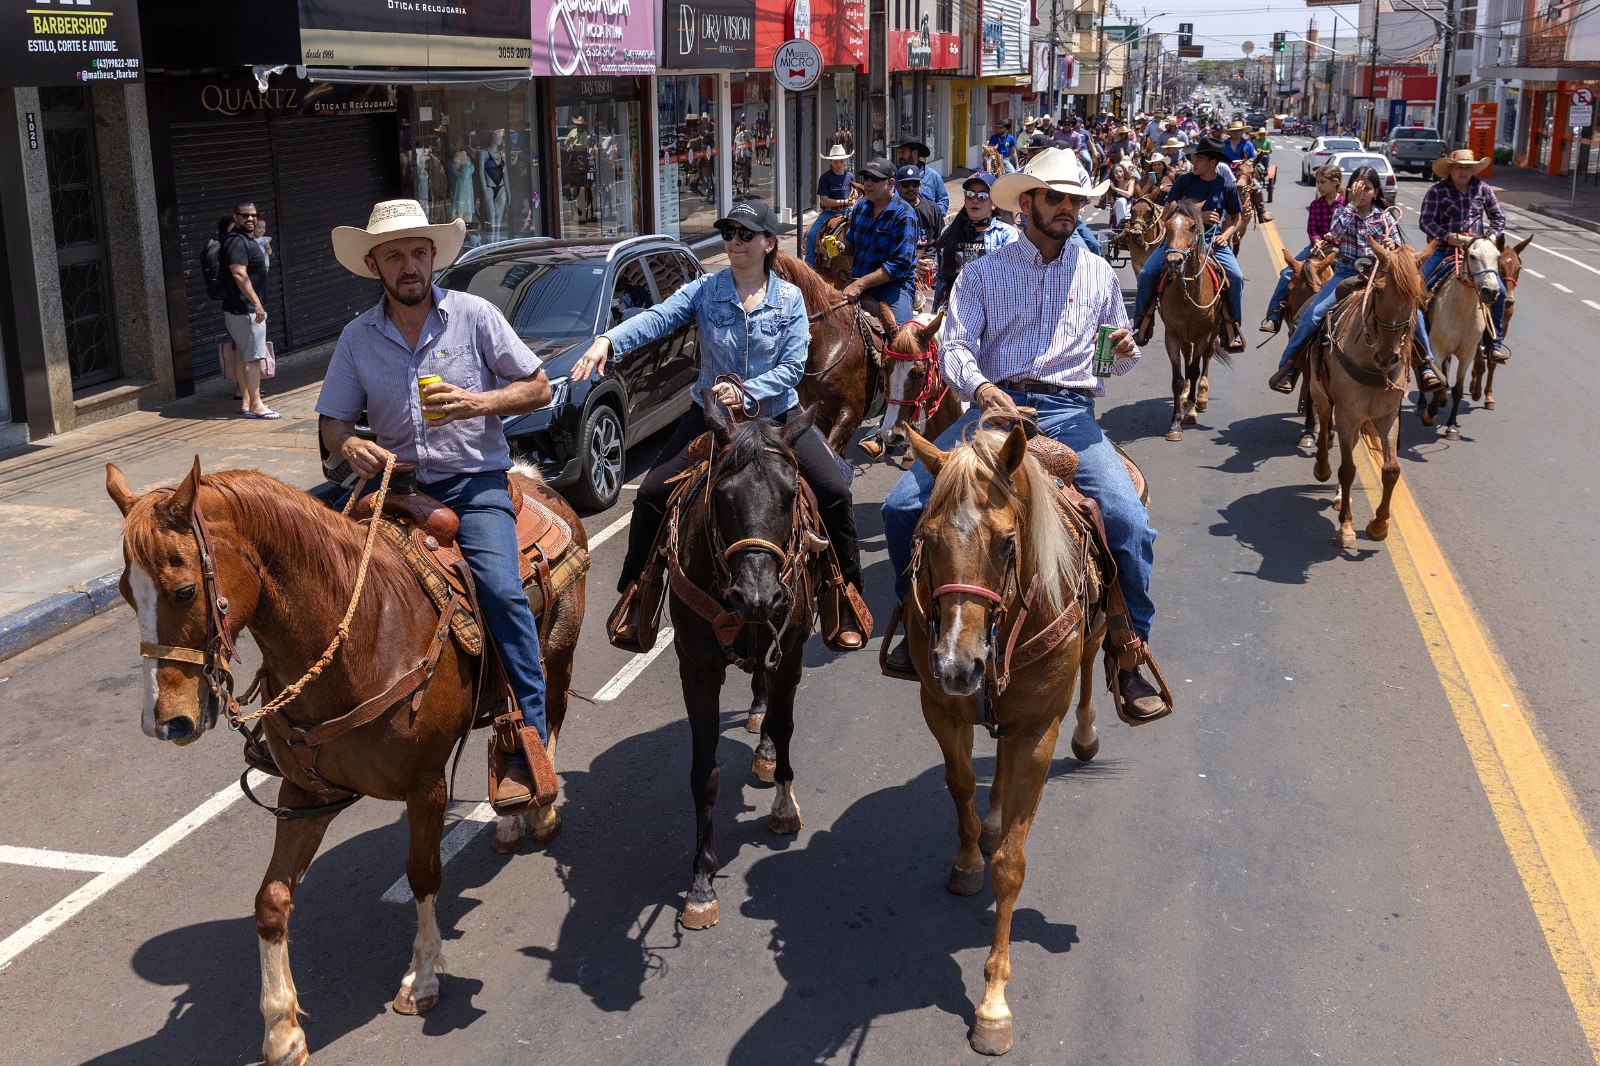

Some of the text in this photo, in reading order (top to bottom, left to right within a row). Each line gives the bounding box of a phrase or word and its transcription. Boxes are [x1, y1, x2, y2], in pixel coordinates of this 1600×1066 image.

[415, 3, 421, 11] E
[33, 16, 108, 35] BARBERSHOP
[701, 14, 751, 43] DRY VISION
[28, 40, 119, 54] ESTILO, CORTE E ATITUDE.
[305, 48, 322, 60] desde
[498, 46, 532, 60] 3055 2073
[780, 57, 815, 68] MICRO
[201, 84, 299, 117] QUARTZ
[314, 100, 340, 111] ÓTICA
[27, 113, 37, 149] 1029
